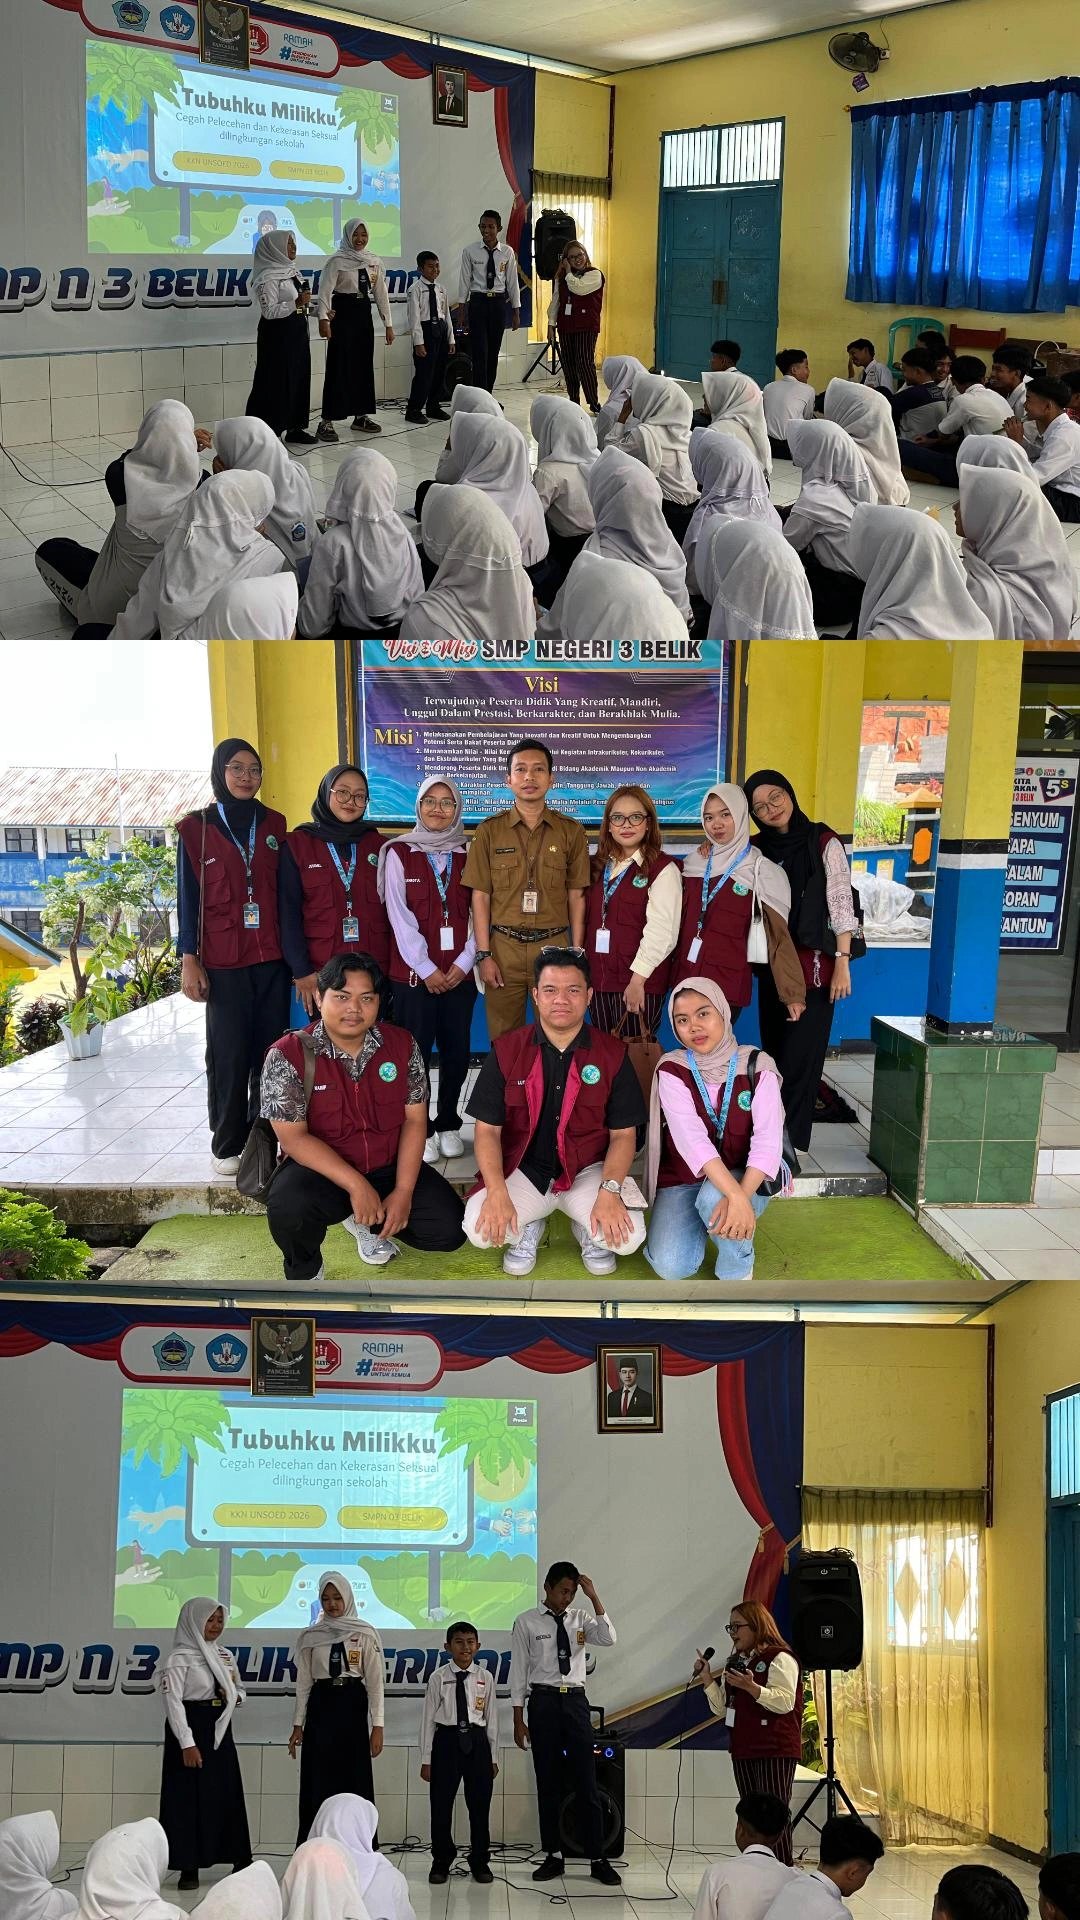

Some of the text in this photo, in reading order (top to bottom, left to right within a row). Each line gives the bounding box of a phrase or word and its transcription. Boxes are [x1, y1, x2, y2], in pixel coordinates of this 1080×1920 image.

[283, 33, 313, 47] RAMAH
[181, 87, 337, 127] Tubuhku Milikku
[175, 112, 339, 142] Cegah Pelecehan dan Kekerasan Seksual
[219, 131, 305, 149] dilingkungan sekolah
[103, 268, 133, 299] 3
[147, 268, 252, 298] BELIK
[384, 640, 418, 659] Visi
[433, 640, 476, 660] Misi
[482, 640, 529, 658] SMP
[535, 640, 612, 659] NEGERI
[619, 640, 634, 660] 3
[639, 640, 701, 660] BELIK
[524, 676, 559, 693] Visi
[424, 696, 661, 708] Terwujudnya Peserta Didik Yang Kreatif, Mandiri,
[404, 709, 681, 719] Unggul Dalam Prestasi, Berkarakter, dan Berakhlak Mulia.
[374, 728, 414, 746] Misi
[1020, 793, 1035, 802] BELIK
[1006, 865, 1043, 881] ALAM
[1003, 891, 1040, 907] OPAN
[1001, 917, 1047, 933] ANTUN
[362, 1342, 404, 1356] RAMAH
[227, 1427, 436, 1454] Tubuhku Milikku
[219, 1457, 439, 1474] Cegah Pelecehan dan Kekerasan Seksual
[272, 1474, 388, 1490] dilingkungan sekolah
[230, 1510, 310, 1520] KKN UNSOED 2026
[362, 1512, 388, 1521] SMPN
[127, 1644, 161, 1681] 3
